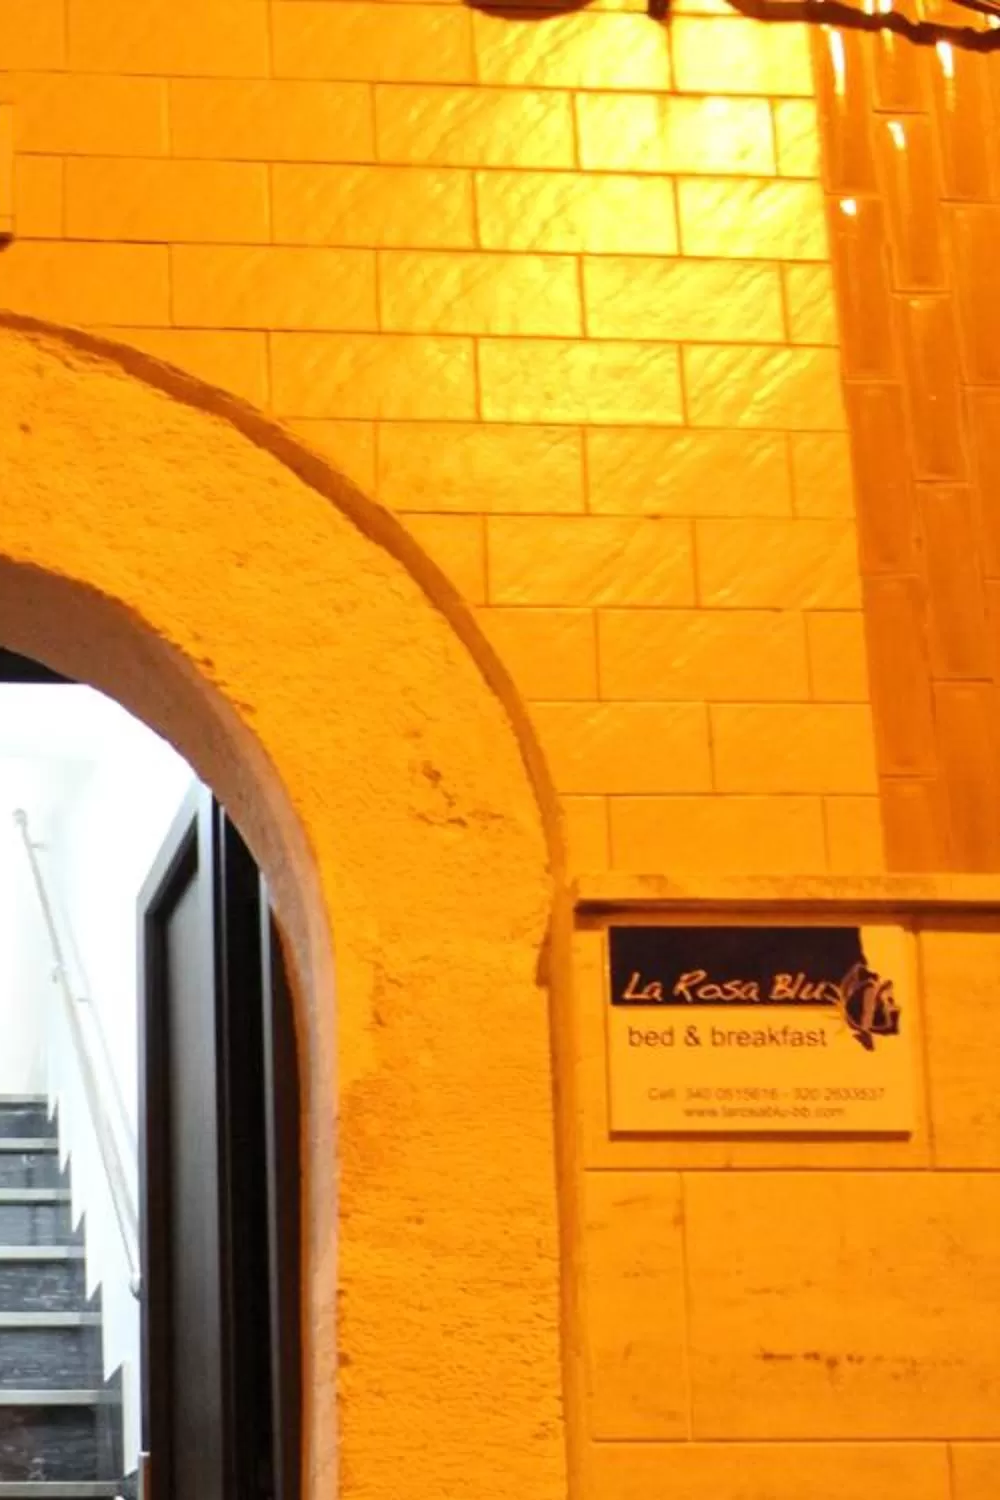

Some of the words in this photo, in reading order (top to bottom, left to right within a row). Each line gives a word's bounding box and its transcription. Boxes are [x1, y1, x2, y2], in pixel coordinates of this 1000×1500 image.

[621, 971, 663, 1002] La
[672, 968, 761, 1003] Rosa
[627, 1025, 675, 1048] bed
[683, 1025, 703, 1048] &
[710, 1025, 828, 1048] breakfast
